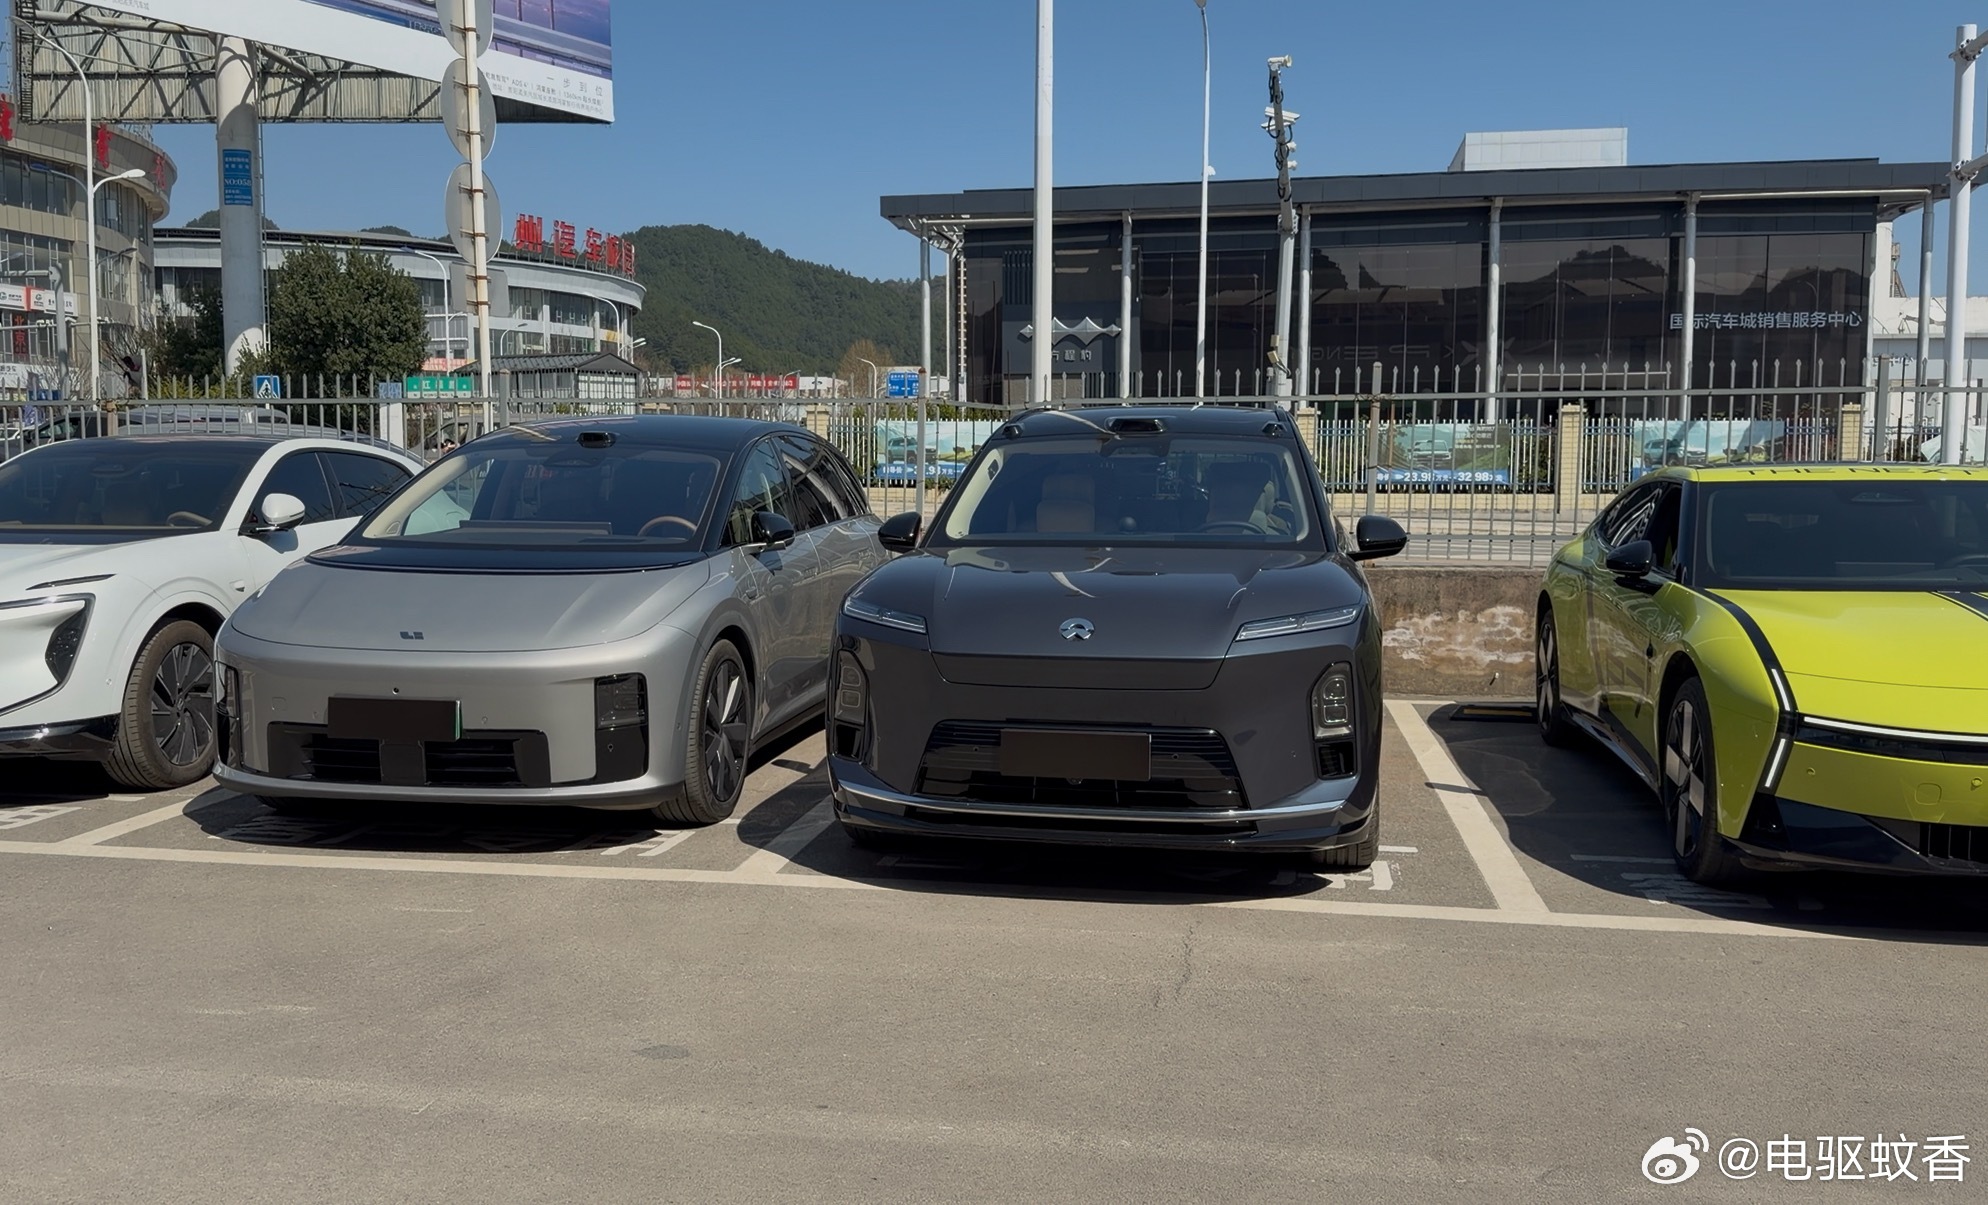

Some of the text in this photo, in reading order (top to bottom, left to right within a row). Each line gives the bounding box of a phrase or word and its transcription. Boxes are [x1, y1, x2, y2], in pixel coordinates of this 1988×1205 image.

[546, 76, 604, 97] 一步到位
[1736, 467, 1980, 476] THE NEXT
